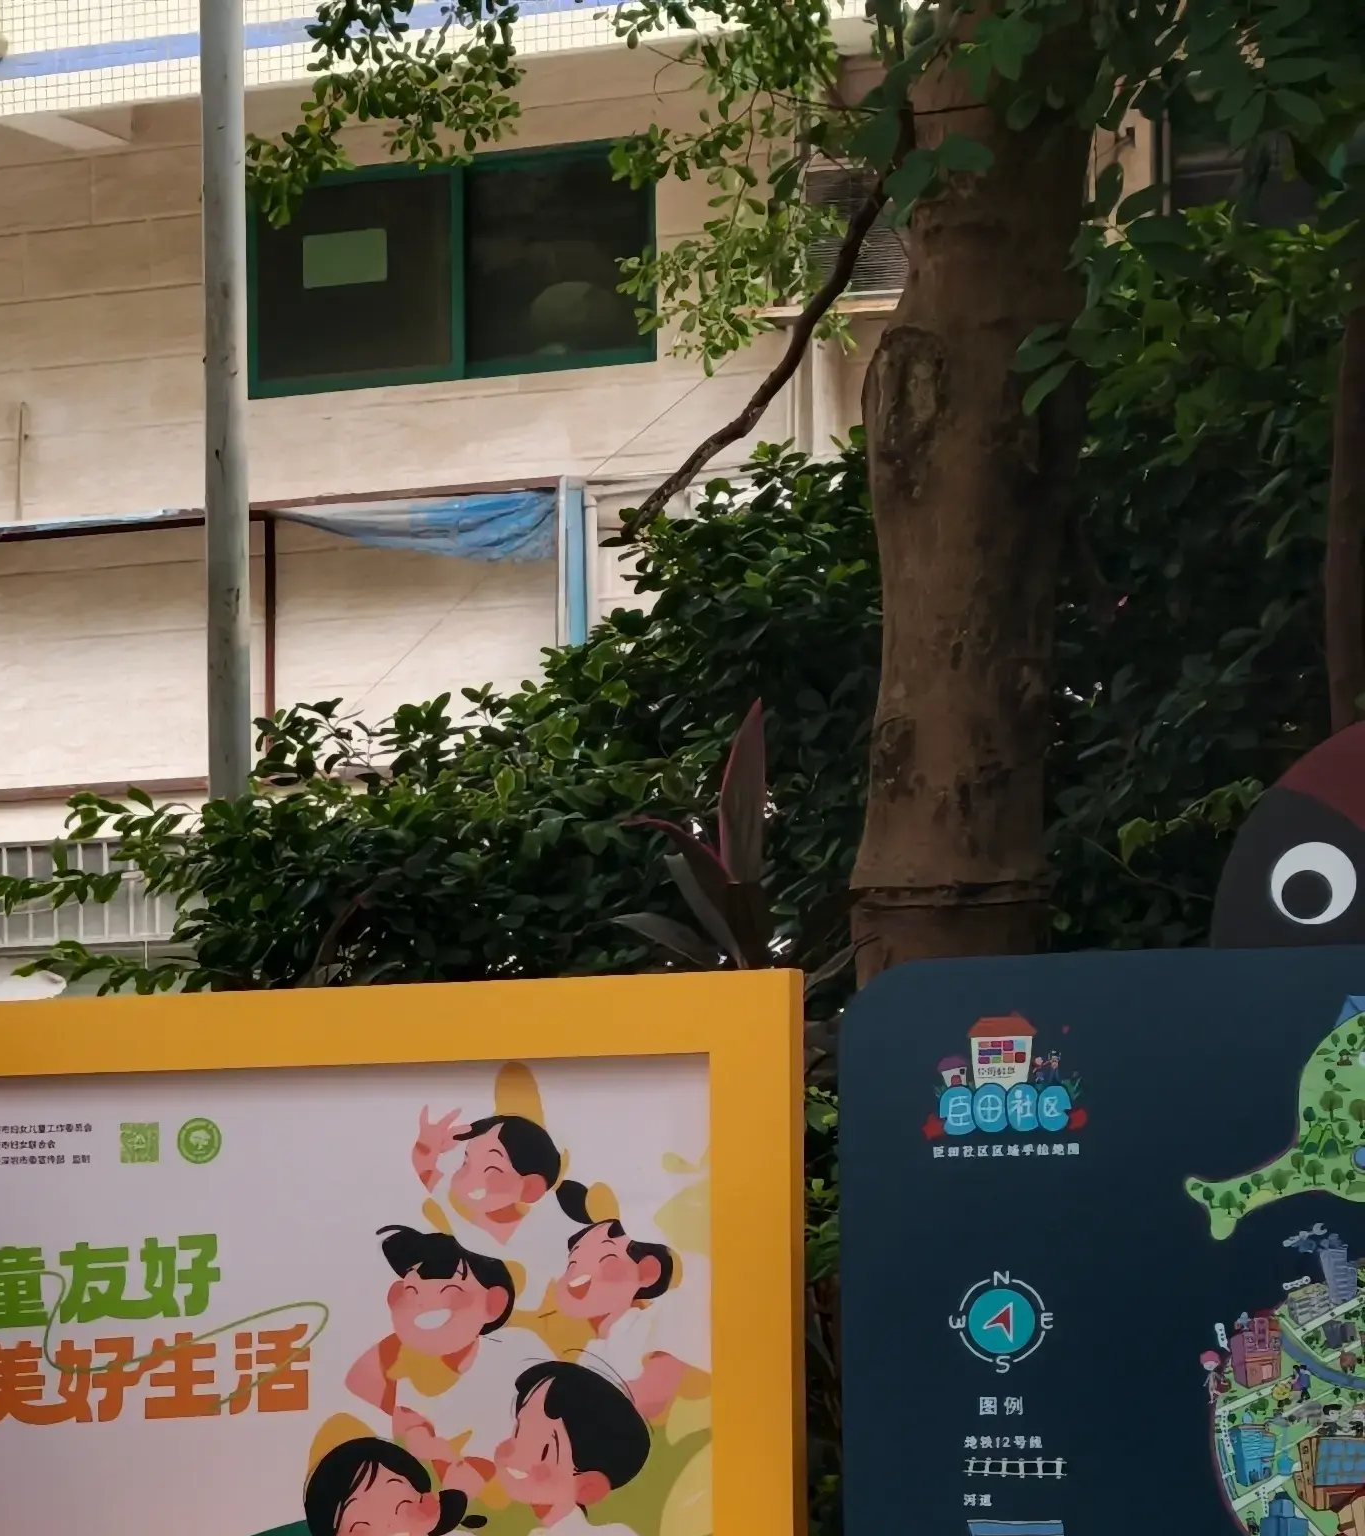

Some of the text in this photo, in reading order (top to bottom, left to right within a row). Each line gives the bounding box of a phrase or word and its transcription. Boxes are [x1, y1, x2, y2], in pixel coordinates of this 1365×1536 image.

[993, 1270, 1010, 1286] N
[1040, 1312, 1054, 1329] E
[995, 1355, 1011, 1374] S
[979, 1396, 1024, 1416] 图例
